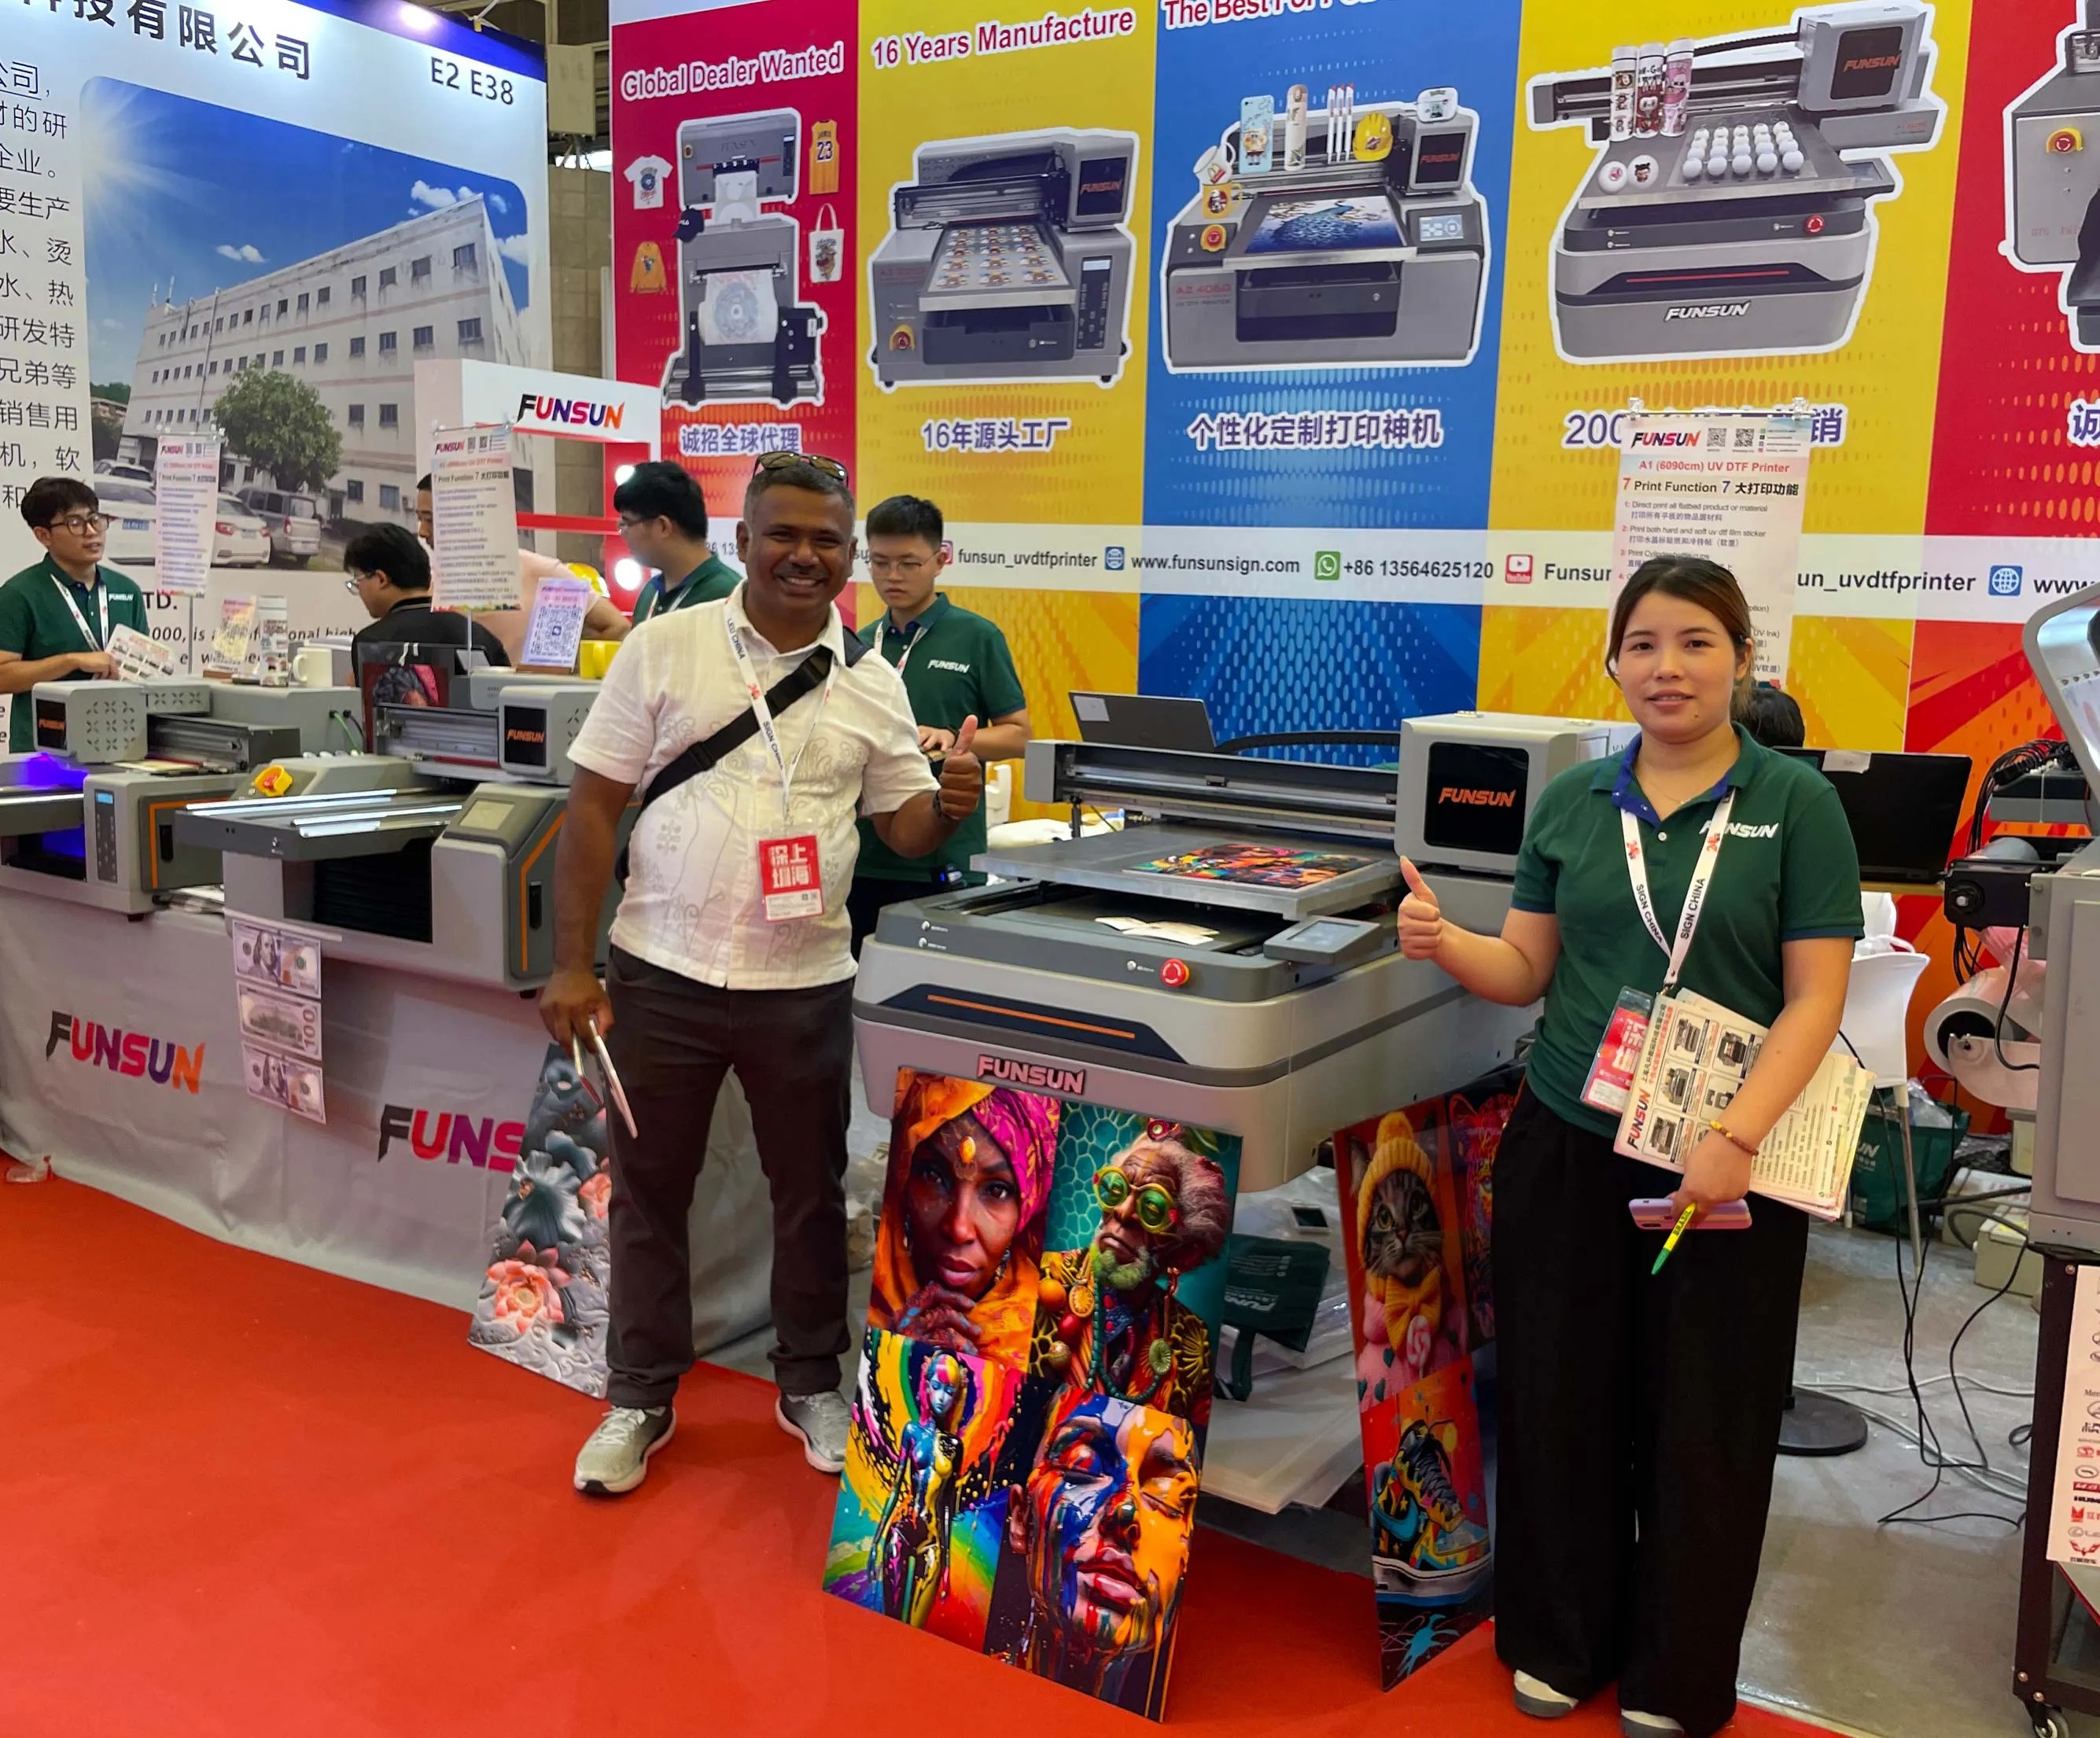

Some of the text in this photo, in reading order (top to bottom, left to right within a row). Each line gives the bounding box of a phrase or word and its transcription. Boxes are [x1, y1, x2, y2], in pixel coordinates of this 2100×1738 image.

[1165, 1, 1207, 26] The
[23, 0, 310, 79] 技有限公司
[874, 11, 1133, 65] 16 Years Manufacture
[624, 45, 842, 98] Global Dealer Wanted
[1843, 53, 1903, 72] FUNSUN
[430, 56, 515, 106] E2 E38
[816, 141, 833, 164] 23
[1664, 300, 1752, 322] FUNSUN
[0, 357, 77, 390] 兄弟等
[0, 399, 79, 432] 销售用
[516, 393, 626, 429] FUNSUN
[681, 425, 801, 455] 诚招全球代理
[923, 422, 1070, 450] 16年源头工厂
[1189, 412, 1442, 447] 个性化定制打印神机
[1630, 430, 1702, 449] FUNSUN
[435, 440, 466, 455] FUNSUN
[1639, 461, 1790, 473] A1 (6090cm) UV DTF Printer
[1623, 477, 1800, 497] 7 Print Function 7 大打印功能
[958, 548, 1098, 569] funsun_uvdtfprinter
[1131, 554, 1300, 575] www.funsunsign.com
[1343, 559, 1374, 576] +86
[1380, 559, 1494, 580] 13564625120
[1797, 570, 1977, 594] un_uvdtfprinter
[142, 592, 178, 610] TD.
[927, 659, 971, 674] FUNSUN
[506, 728, 546, 744] FUNSUN
[762, 720, 776, 743] SIGN
[1438, 786, 1517, 808] FUNSUN
[1699, 819, 1780, 839] FNSUN
[1636, 883, 1663, 944] SIGN CHINA
[1680, 877, 1706, 940] SIGN CHINA
[46, 1010, 207, 1095] FUNSUN
[976, 1054, 1087, 1096] FUNSUN
[1627, 1087, 1652, 1151] FUNSUN
[378, 1103, 527, 1174] FUNS
